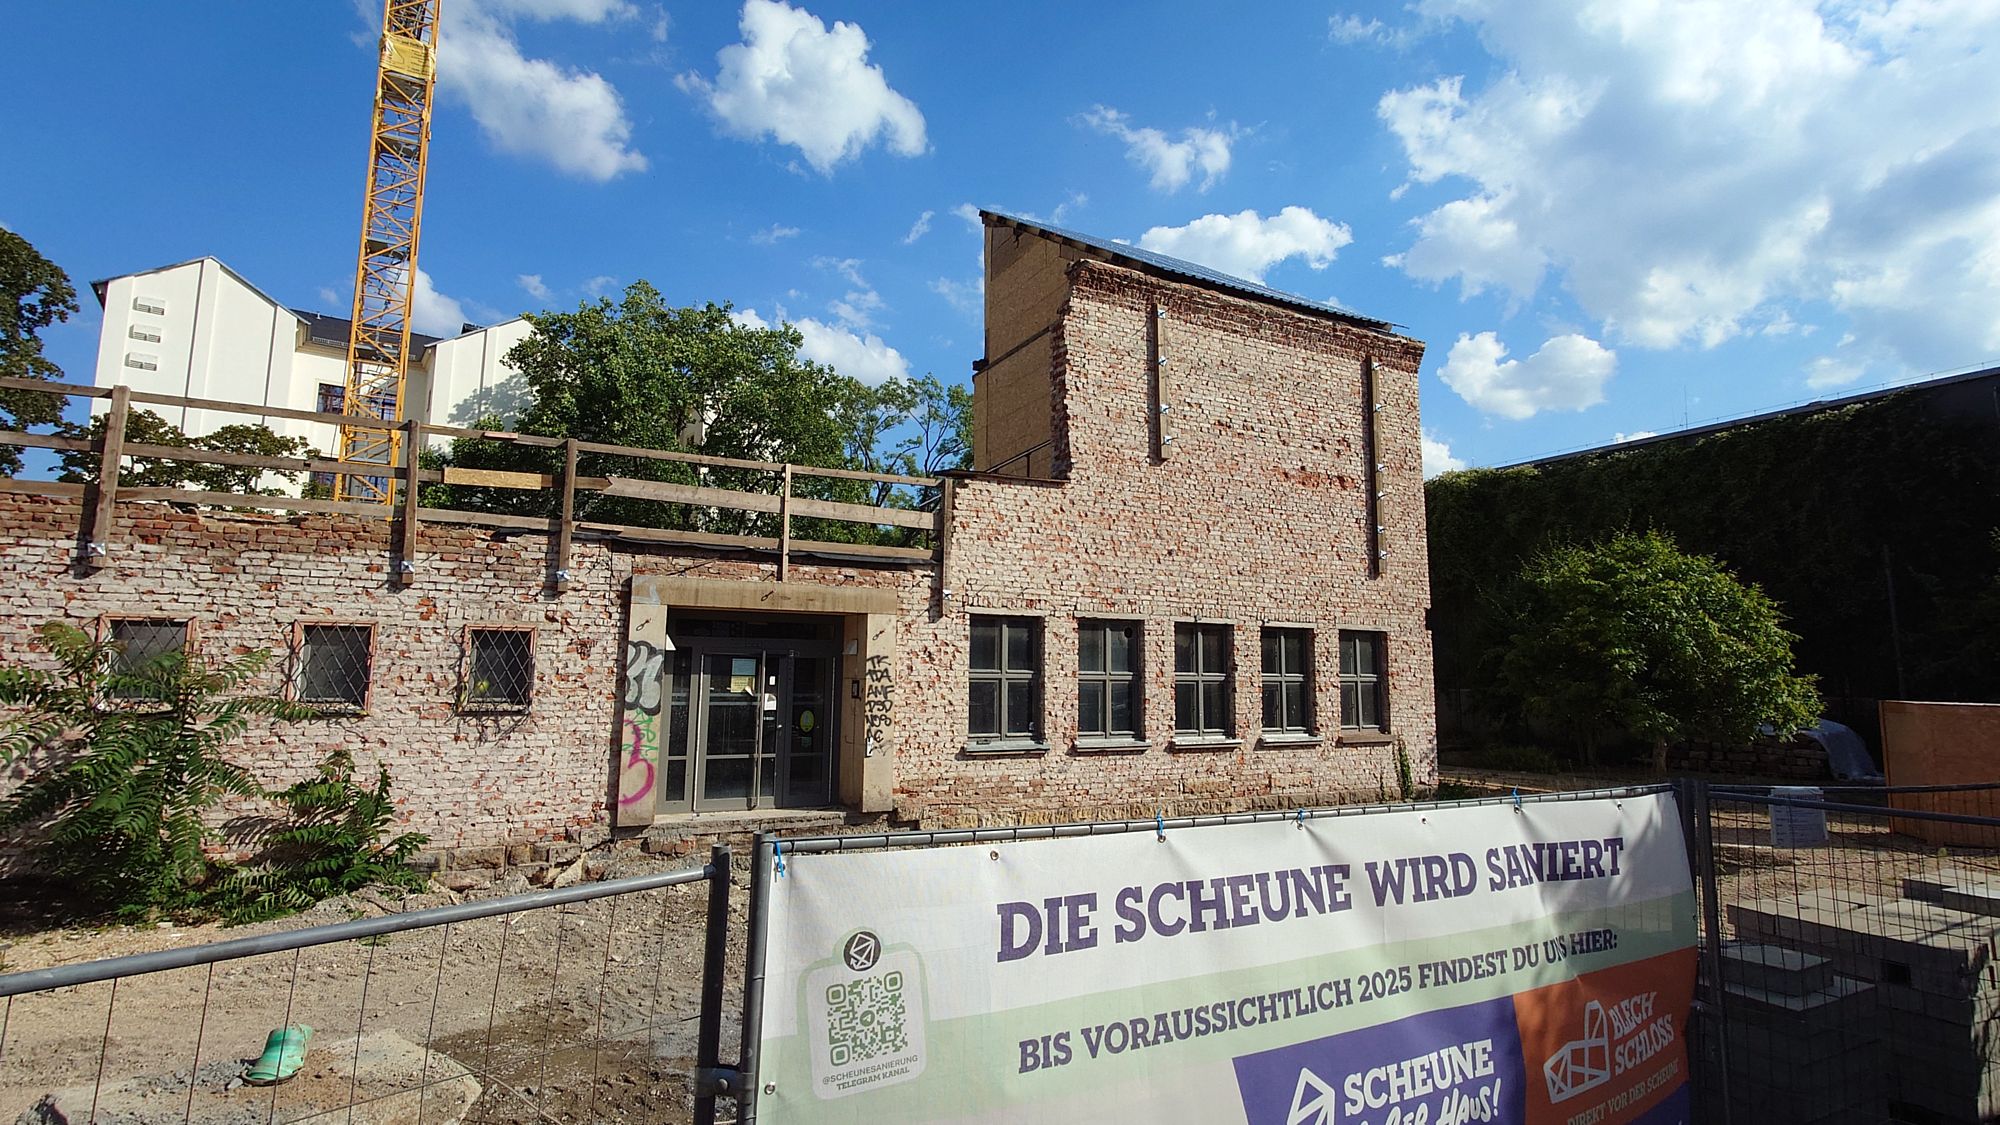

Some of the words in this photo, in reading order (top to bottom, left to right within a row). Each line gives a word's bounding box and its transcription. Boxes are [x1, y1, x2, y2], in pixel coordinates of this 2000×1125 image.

[997, 892, 1098, 962] DIE
[1114, 864, 1352, 943] SCHEUNE
[1365, 852, 1477, 907] WIRD
[1486, 838, 1623, 892] SANIERT
[1018, 1031, 1072, 1073] BIS
[1081, 978, 1352, 1058] VORAUSSICHTLICH
[1358, 966, 1411, 1002] 2025
[1418, 950, 1507, 988] FINDEST
[1512, 944, 1538, 971] DU
[1569, 929, 1617, 955] HIER:
[1608, 992, 1657, 1040] BLECH
[1615, 1014, 1674, 1075] SCHLOSS
[822, 1055, 918, 1085] @SCHEUNESANIERUNG
[836, 1073, 881, 1090] TELEGRAM
[882, 1066, 910, 1080] KANAL
[1344, 1039, 1494, 1116] SCHEUNE
[1435, 1078, 1501, 1125] HAUS!
[1607, 1092, 1628, 1115] VOR
[1629, 1082, 1645, 1104] DER
